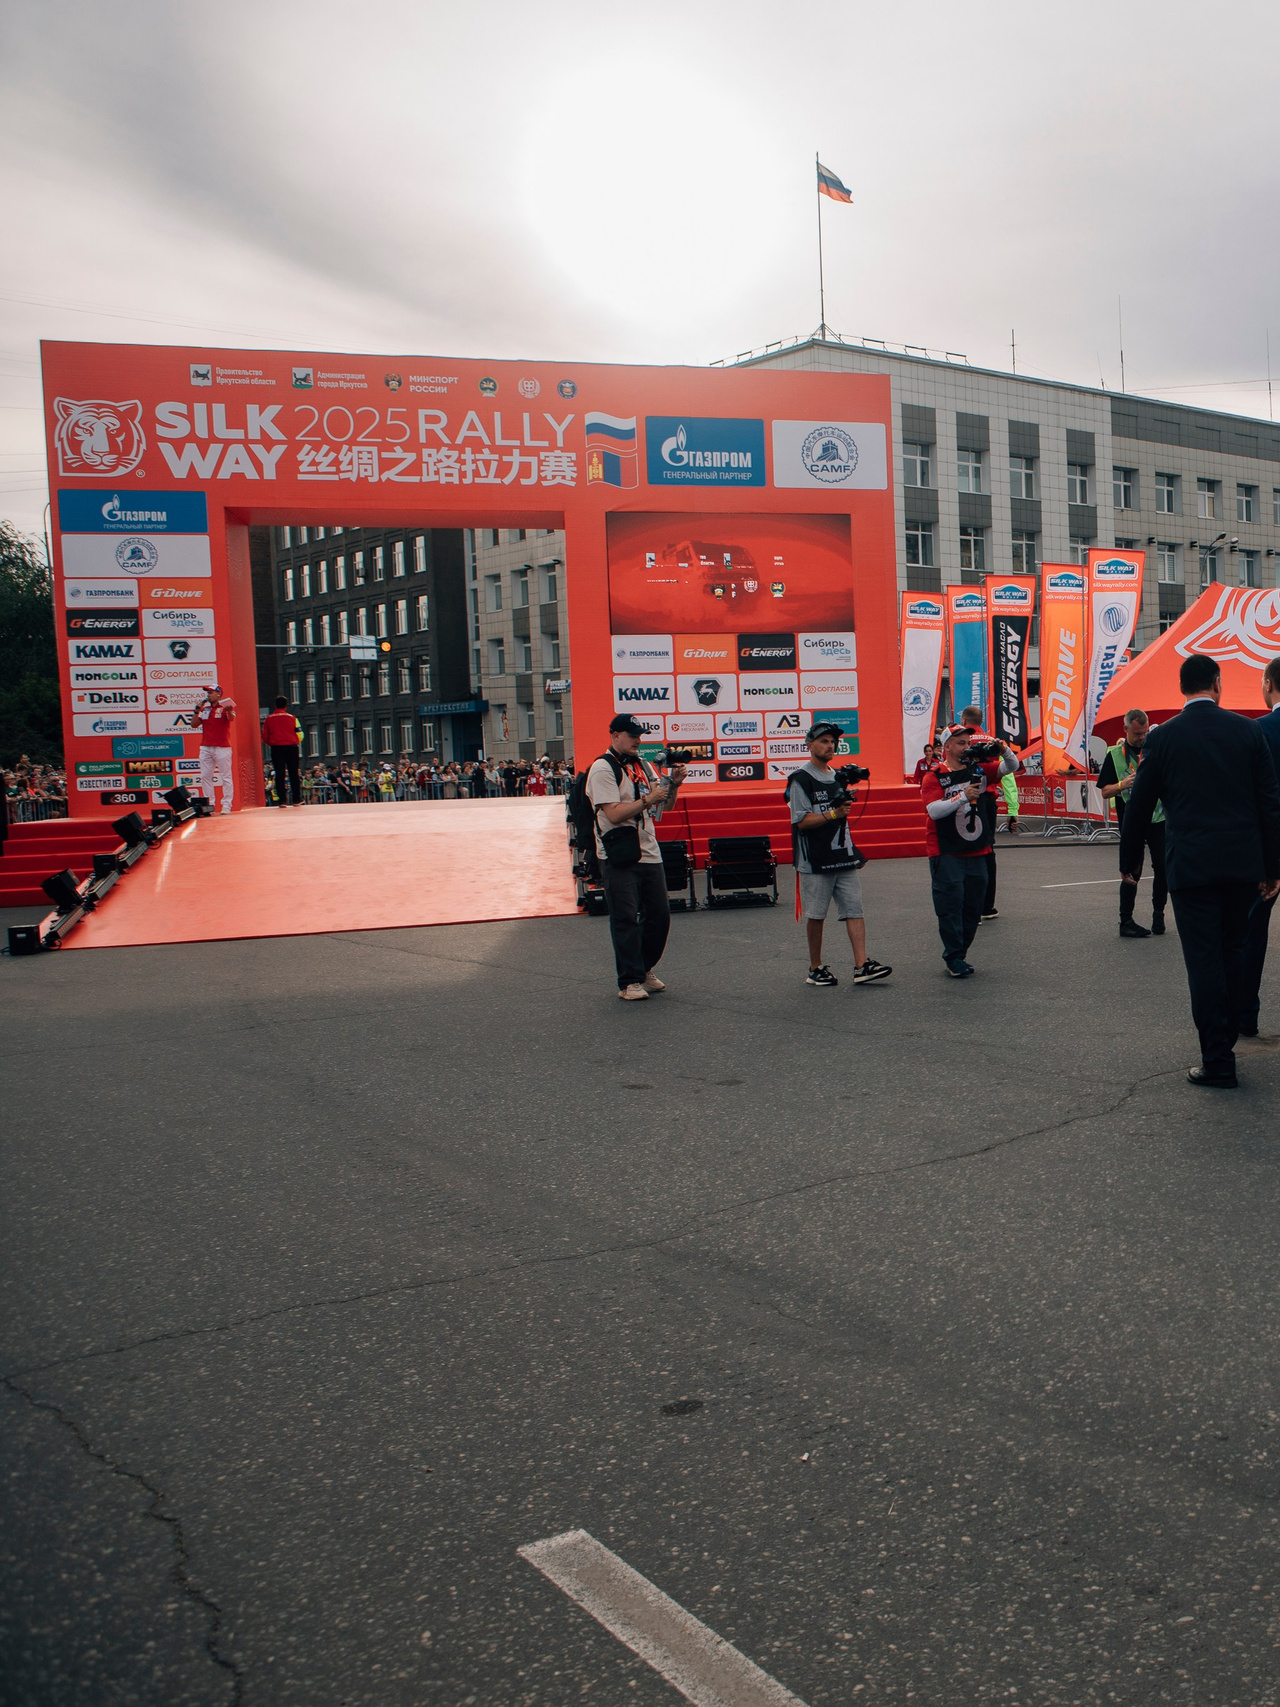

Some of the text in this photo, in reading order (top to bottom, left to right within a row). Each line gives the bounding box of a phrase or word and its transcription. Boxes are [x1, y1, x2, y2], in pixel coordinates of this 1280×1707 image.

[215, 367, 263, 376] Правительство
[317, 370, 366, 380] Администрация
[216, 376, 276, 386] Иркутской области
[317, 381, 368, 389] города Иркутска
[409, 375, 459, 385] МИНСПОРТ
[409, 385, 448, 394] РОССИИ
[155, 401, 576, 448] SILK 2025 RALLY
[157, 442, 288, 480] WAY
[689, 451, 752, 468] ГАЗПРОМ
[297, 444, 577, 487] 丝绸之路拉力赛
[810, 464, 850, 474] CAMF
[663, 470, 753, 481] ГЕНЕРАЛЬНЫЙ ПАРТНЕР
[121, 510, 167, 522] ГАЗПРОМ
[86, 589, 135, 597] ГАЗПРОМБАНК
[152, 610, 197, 621] Сибирь
[171, 619, 204, 628] здесь
[803, 639, 845, 649] Сибирь
[75, 644, 134, 658] KAMAZ
[820, 647, 851, 656] здесь
[75, 672, 138, 681] MONGOLIA
[166, 670, 214, 678] СОГЛАСИЕ
[1001, 655, 1009, 708] МОТОРНОЕ
[618, 687, 670, 701] KAMAZ
[743, 687, 794, 696] MONGOLIA
[89, 692, 139, 704] Delko
[769, 744, 800, 754] ИЗВЕСТИЯ
[128, 761, 171, 773] МАТЧ!
[730, 766, 754, 776] 360
[687, 769, 713, 778] 2ГИС
[79, 779, 111, 788] ИЗВЕСТИЯ
[114, 793, 136, 803] 360
